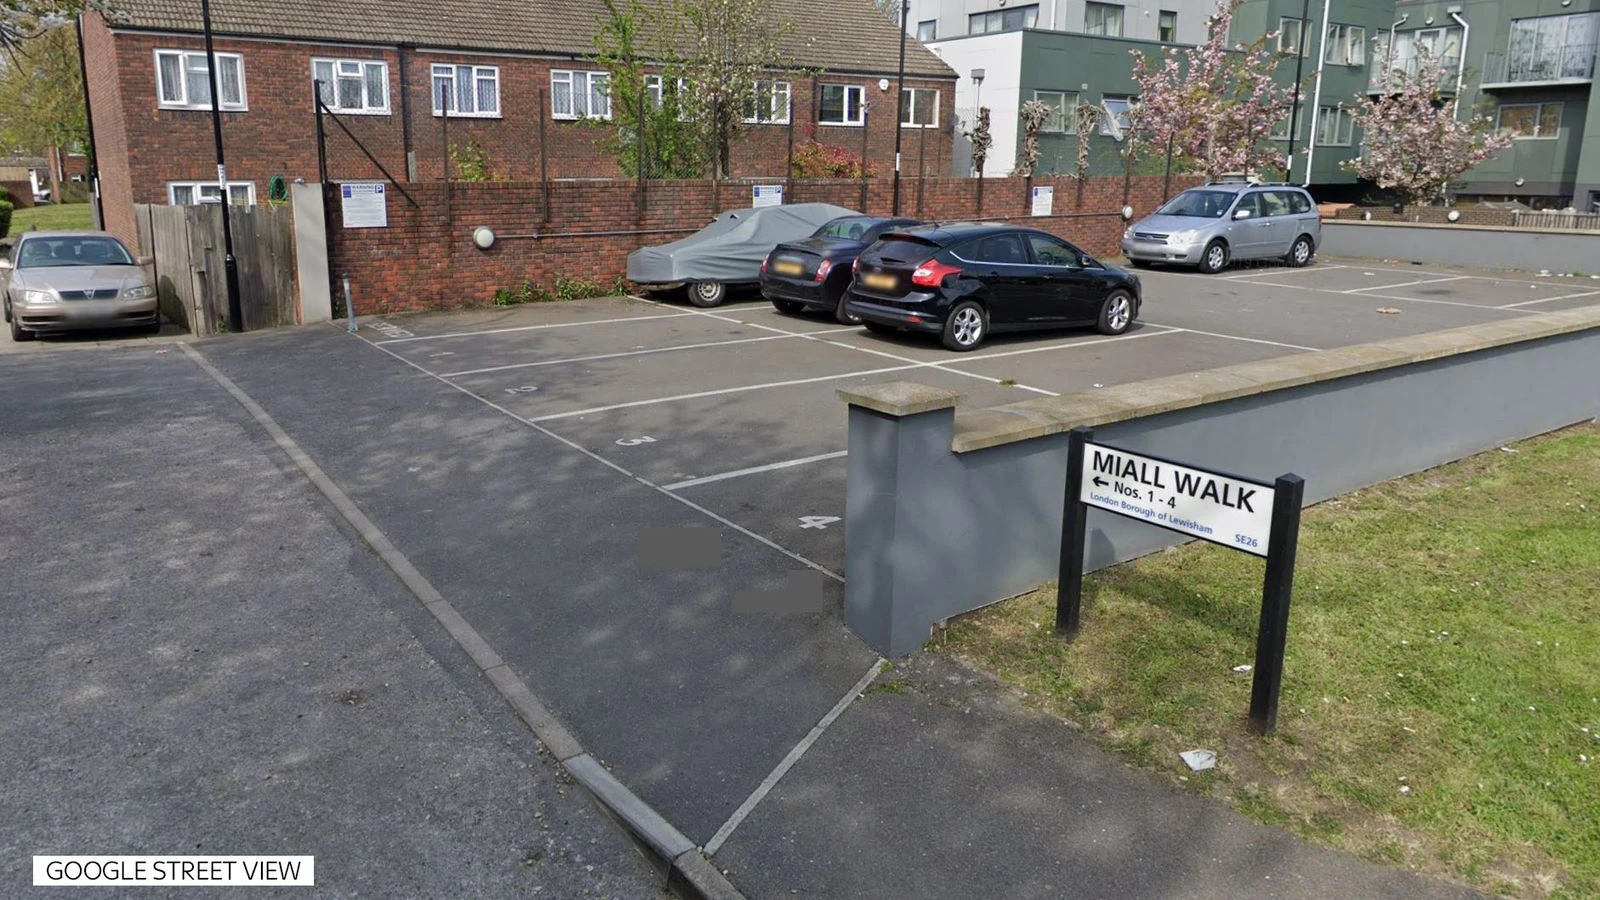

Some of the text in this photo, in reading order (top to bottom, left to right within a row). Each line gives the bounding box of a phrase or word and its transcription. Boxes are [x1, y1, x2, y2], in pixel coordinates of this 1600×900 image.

[504, 385, 539, 395] 2
[615, 435, 658, 447] 3
[1093, 450, 1257, 513] MIALL WALK
[1114, 481, 1142, 500] Nos.
[1147, 490, 1154, 503] 1
[1167, 496, 1176, 509] 4
[1090, 491, 1213, 535] London Borough of Lewisham
[798, 515, 842, 530] 4
[1235, 533, 1258, 548] SE26
